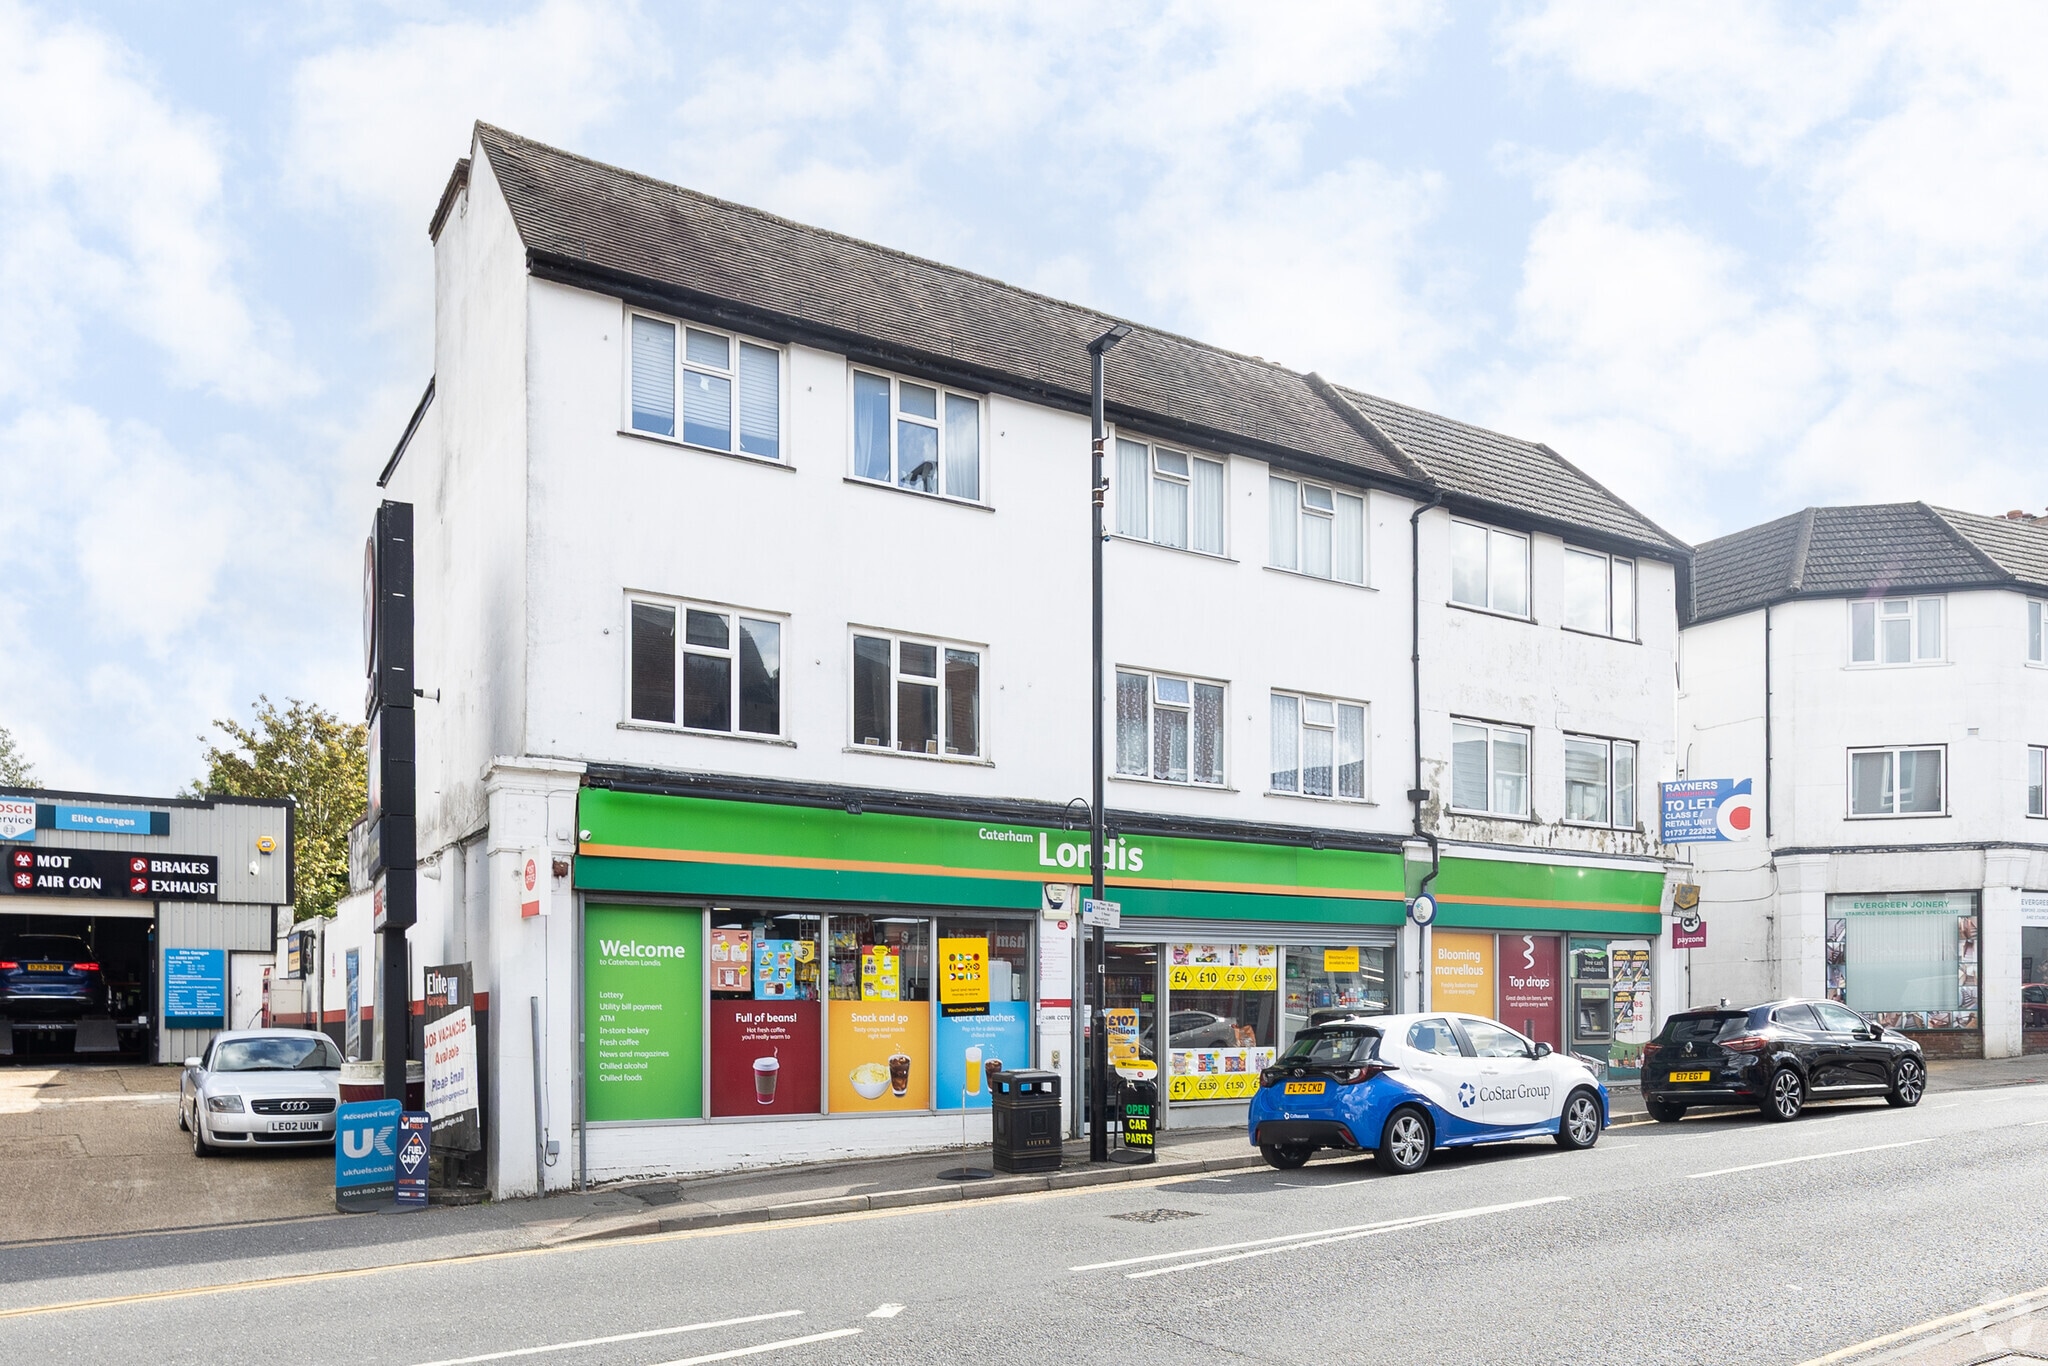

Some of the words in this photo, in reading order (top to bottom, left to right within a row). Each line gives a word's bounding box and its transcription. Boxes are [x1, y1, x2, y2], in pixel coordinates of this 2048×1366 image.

[1665, 781, 1718, 792] RAYNERS
[1665, 800, 1685, 811] TO
[1688, 798, 1716, 810] LET
[71, 814, 94, 824] Elite
[95, 815, 136, 827] Garages
[1665, 811, 1692, 819] CLASS
[1665, 820, 1693, 828] RETAIL
[979, 828, 1034, 843] Caterham
[1664, 829, 1688, 837] 01737
[1039, 832, 1144, 872] Londis
[37, 855, 72, 868] MOT
[151, 860, 210, 875] BRAKES
[37, 875, 65, 888] AIR
[68, 876, 102, 890] CON
[151, 880, 217, 895] EXHAUST
[1853, 901, 1909, 909] EVERGREEN
[1910, 901, 1950, 909] JOINERY
[1677, 936, 1705, 945] payzone
[600, 939, 686, 958] Welcome
[1438, 948, 1481, 963] Blooming
[641, 959, 661, 967] Londis
[1435, 964, 1484, 976] marvellous
[426, 969, 448, 995] Elite
[1174, 971, 1188, 983] £4
[1200, 972, 1217, 983] £10
[1227, 973, 1245, 982] £7.50
[1254, 974, 1272, 983] £5.99
[1509, 976, 1525, 990] Top
[1526, 976, 1550, 990] drops
[600, 991, 624, 1000] Lottery
[600, 1003, 621, 1012] Utility
[633, 1004, 663, 1012] payment
[600, 1014, 616, 1022] ATM
[735, 1013, 753, 1023] Full
[754, 1012, 766, 1023] of
[766, 1013, 797, 1023] beans!
[851, 1012, 878, 1023] Snack
[878, 1013, 896, 1022] and
[897, 1015, 909, 1025] go
[951, 1014, 974, 1024] Quick
[975, 1013, 1016, 1024] quenchers
[1108, 1015, 1136, 1027] £107
[600, 1026, 626, 1034] In-store
[627, 1026, 650, 1035] bakery
[1108, 1026, 1136, 1036] Million
[600, 1038, 618, 1046] Fresh
[618, 1038, 640, 1046] coffee
[600, 1050, 618, 1058] News
[633, 1050, 670, 1059] magazines
[600, 1062, 623, 1070] Chilled
[623, 1062, 648, 1070] alcohol
[600, 1074, 623, 1082] Chilled
[1676, 1072, 1688, 1081] E17
[1688, 1072, 1703, 1081] EGT
[1173, 1081, 1186, 1093] £1
[1198, 1082, 1217, 1091] £3.50
[1226, 1081, 1244, 1090] £1.50
[1287, 1083, 1307, 1093] FL75
[1307, 1083, 1323, 1093] CKD
[1479, 1086, 1517, 1102] CoStar
[1517, 1084, 1551, 1100] Group
[343, 1111, 378, 1120] Accepted
[379, 1110, 396, 1118] here
[1126, 1104, 1150, 1115] OPEN
[271, 1121, 298, 1131] LE02
[1128, 1118, 1148, 1131] CAR
[343, 1125, 395, 1159] UK
[1125, 1132, 1154, 1145] PARTS
[407, 1145, 423, 1155] FUEL
[402, 1154, 421, 1164] CARD
[342, 1164, 395, 1177] ukfuels.co.uk
[342, 1189, 362, 1198] 0344
